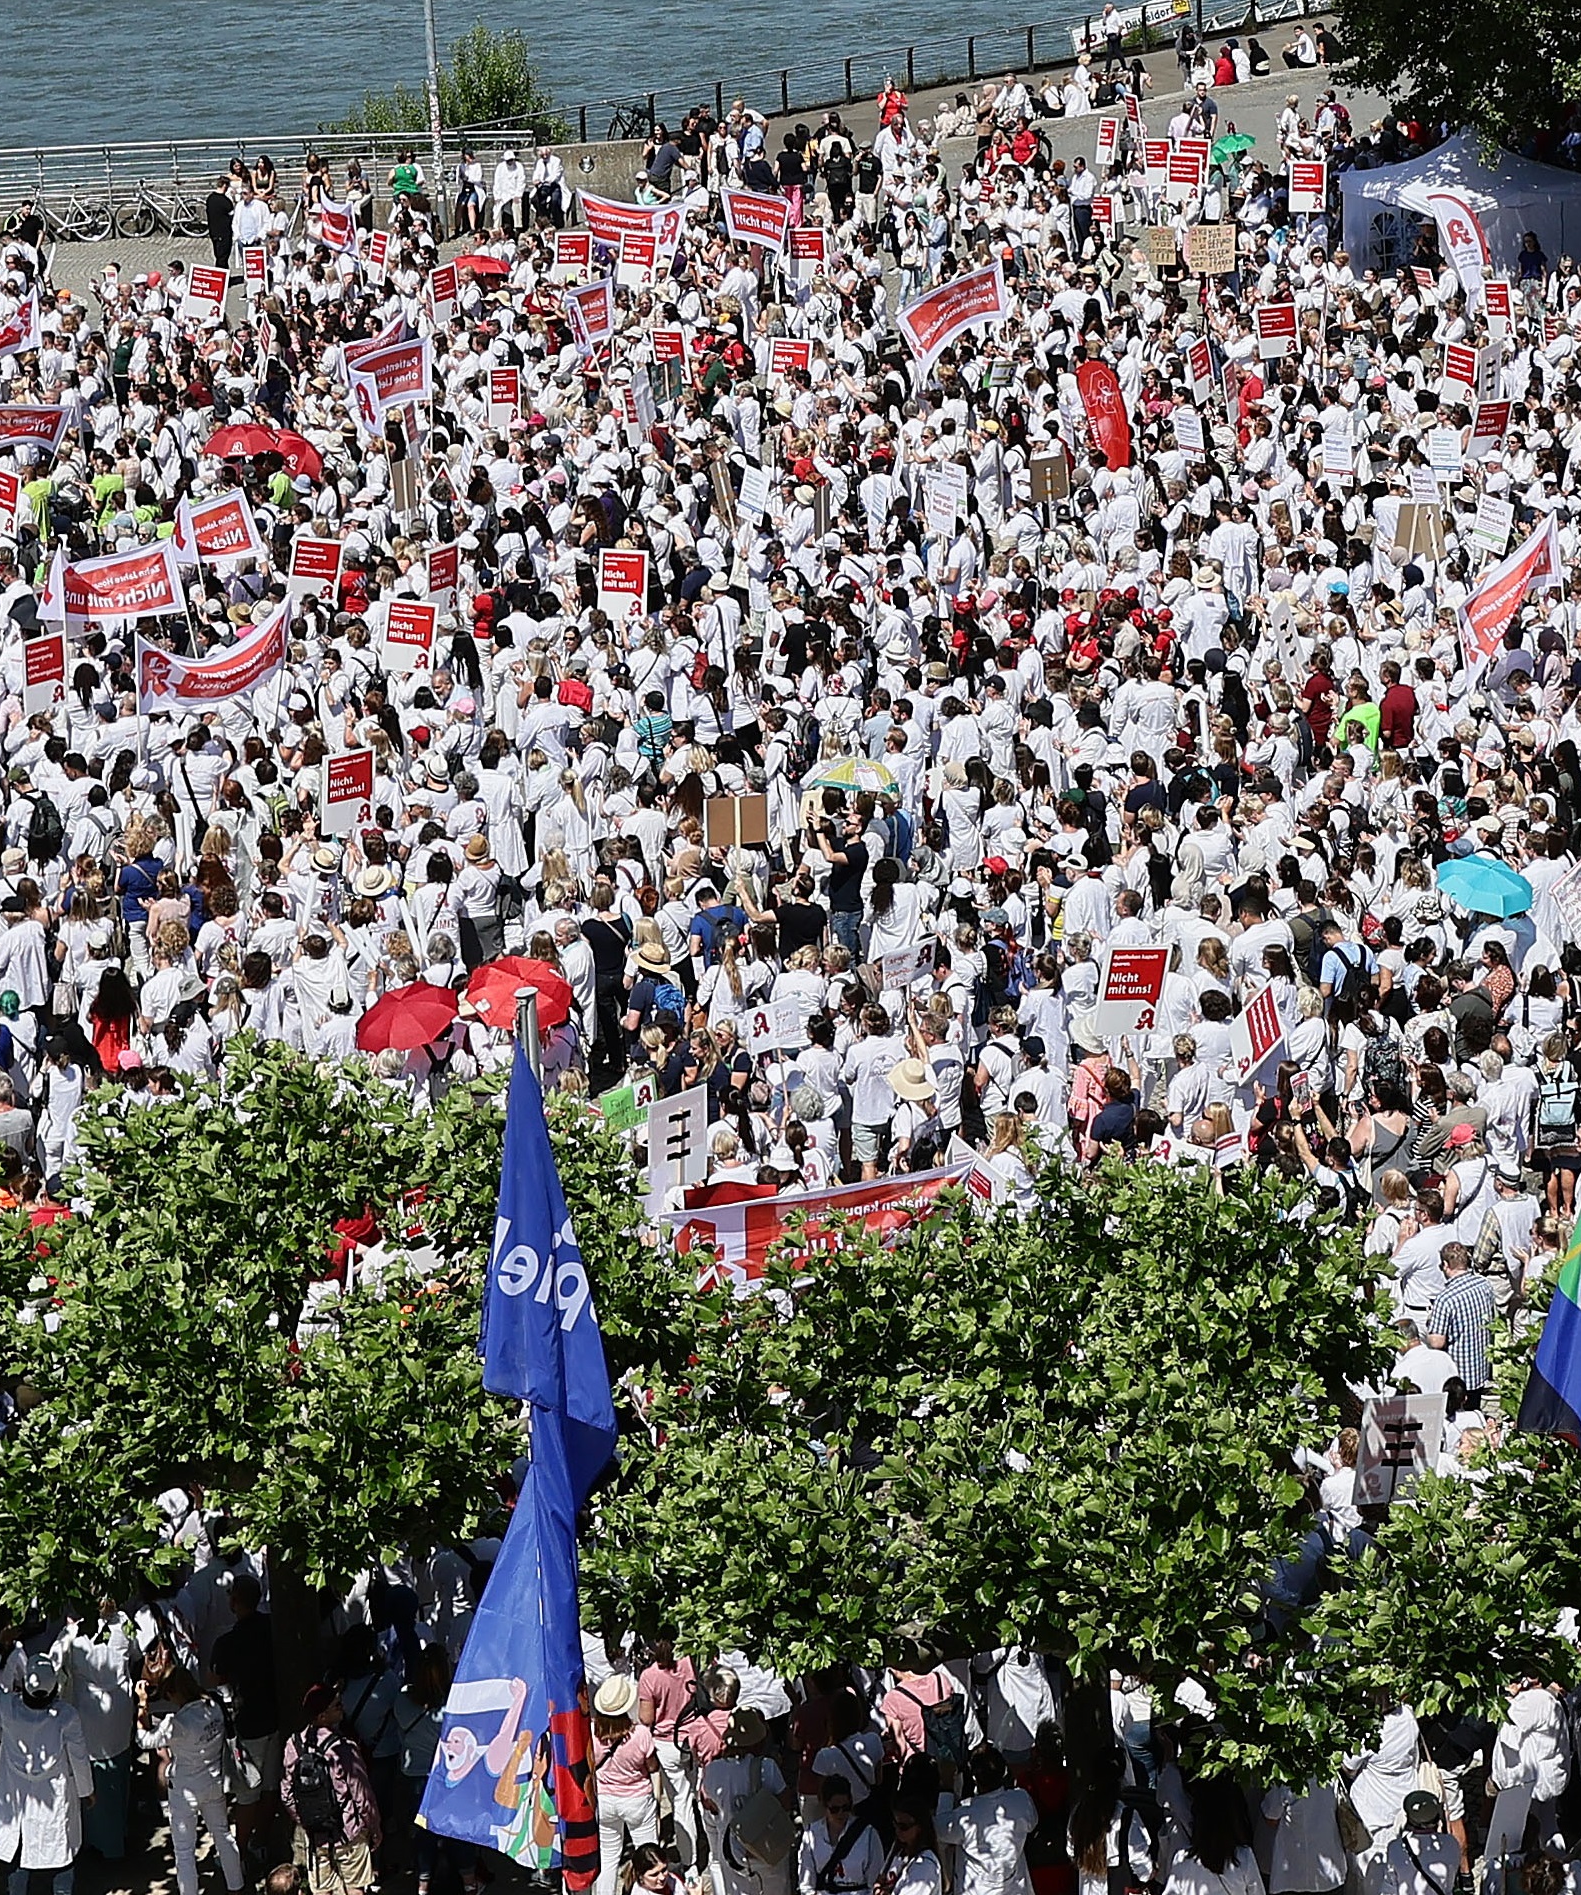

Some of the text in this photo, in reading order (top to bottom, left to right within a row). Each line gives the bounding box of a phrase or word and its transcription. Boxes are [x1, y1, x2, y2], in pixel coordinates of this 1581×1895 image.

[605, 570, 625, 579] Nicht
[390, 621, 413, 631] Nicht
[389, 631, 404, 639] mit
[329, 777, 353, 787] Nicht
[328, 783, 365, 798] mit uns!
[1110, 973, 1138, 982] Nicht
[1108, 984, 1151, 994] mit uns!
